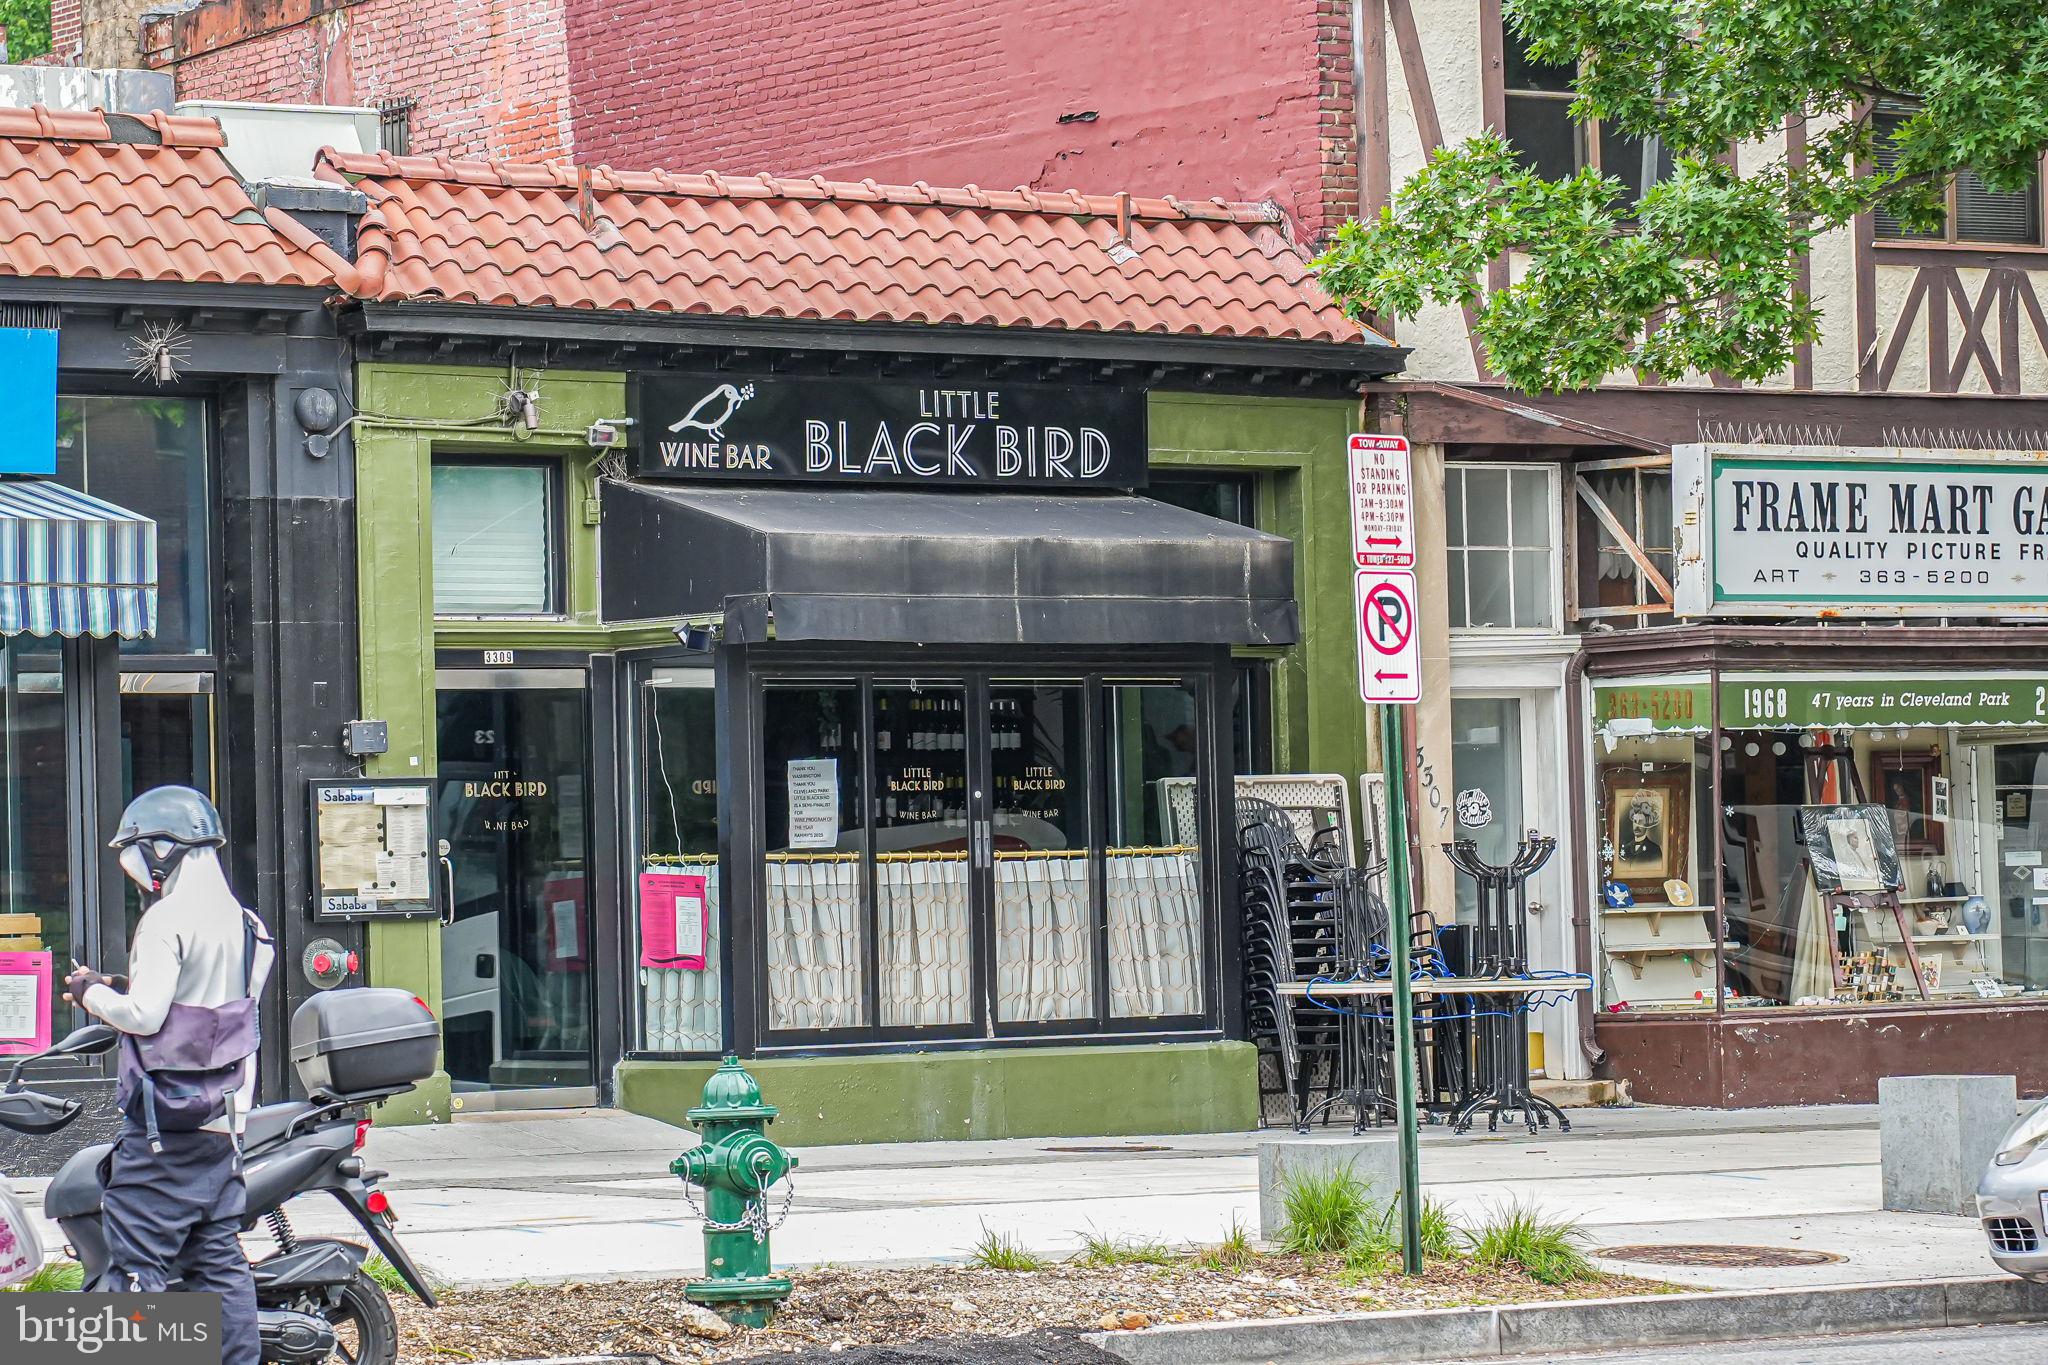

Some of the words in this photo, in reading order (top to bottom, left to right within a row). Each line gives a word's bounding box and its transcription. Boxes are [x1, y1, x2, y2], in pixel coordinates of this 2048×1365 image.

[919, 389, 999, 420] LITTLE
[659, 441, 720, 468] WINE
[726, 443, 773, 470] BAR
[805, 419, 978, 477] BLACK
[996, 425, 1111, 479] BIRD
[1374, 453, 1385, 465] NO
[1361, 467, 1400, 481] STANDING
[1356, 482, 1367, 494] OR
[1371, 482, 1407, 496] PARKING
[1732, 480, 1868, 532] FRAME
[1889, 483, 1994, 535] MART
[1361, 511, 1405, 522] 4PM-6:30PM
[1796, 541, 1889, 559] QUALITY
[1907, 542, 2001, 560] PICTURE
[2020, 543, 2048, 561] FR
[1753, 569, 1800, 583] ART
[1859, 570, 1990, 584] 363-5200
[485, 651, 513, 663] 3309
[1744, 688, 1788, 719] 1968
[1812, 692, 1832, 708] 47
[1836, 693, 1875, 710] years
[1881, 691, 1896, 707] in
[1900, 692, 1972, 707] Cleveland
[1978, 691, 2011, 706] Park
[2035, 686, 2046, 716] 2
[903, 767, 932, 778] LITTLE
[1025, 766, 1053, 777] LITTLE
[465, 782, 511, 797] BLACK
[515, 781, 547, 797] BIRD
[891, 780, 921, 791] BLACK
[923, 780, 945, 791] BIRD
[1013, 780, 1043, 791] BLACK
[1045, 780, 1066, 790] BIRD
[324, 789, 364, 802] Sababa
[899, 810, 919, 820] WINE
[921, 810, 937, 820] BAR
[1021, 809, 1042, 819] WINE
[1043, 808, 1060, 819] BAR
[328, 897, 367, 911] Sababa
